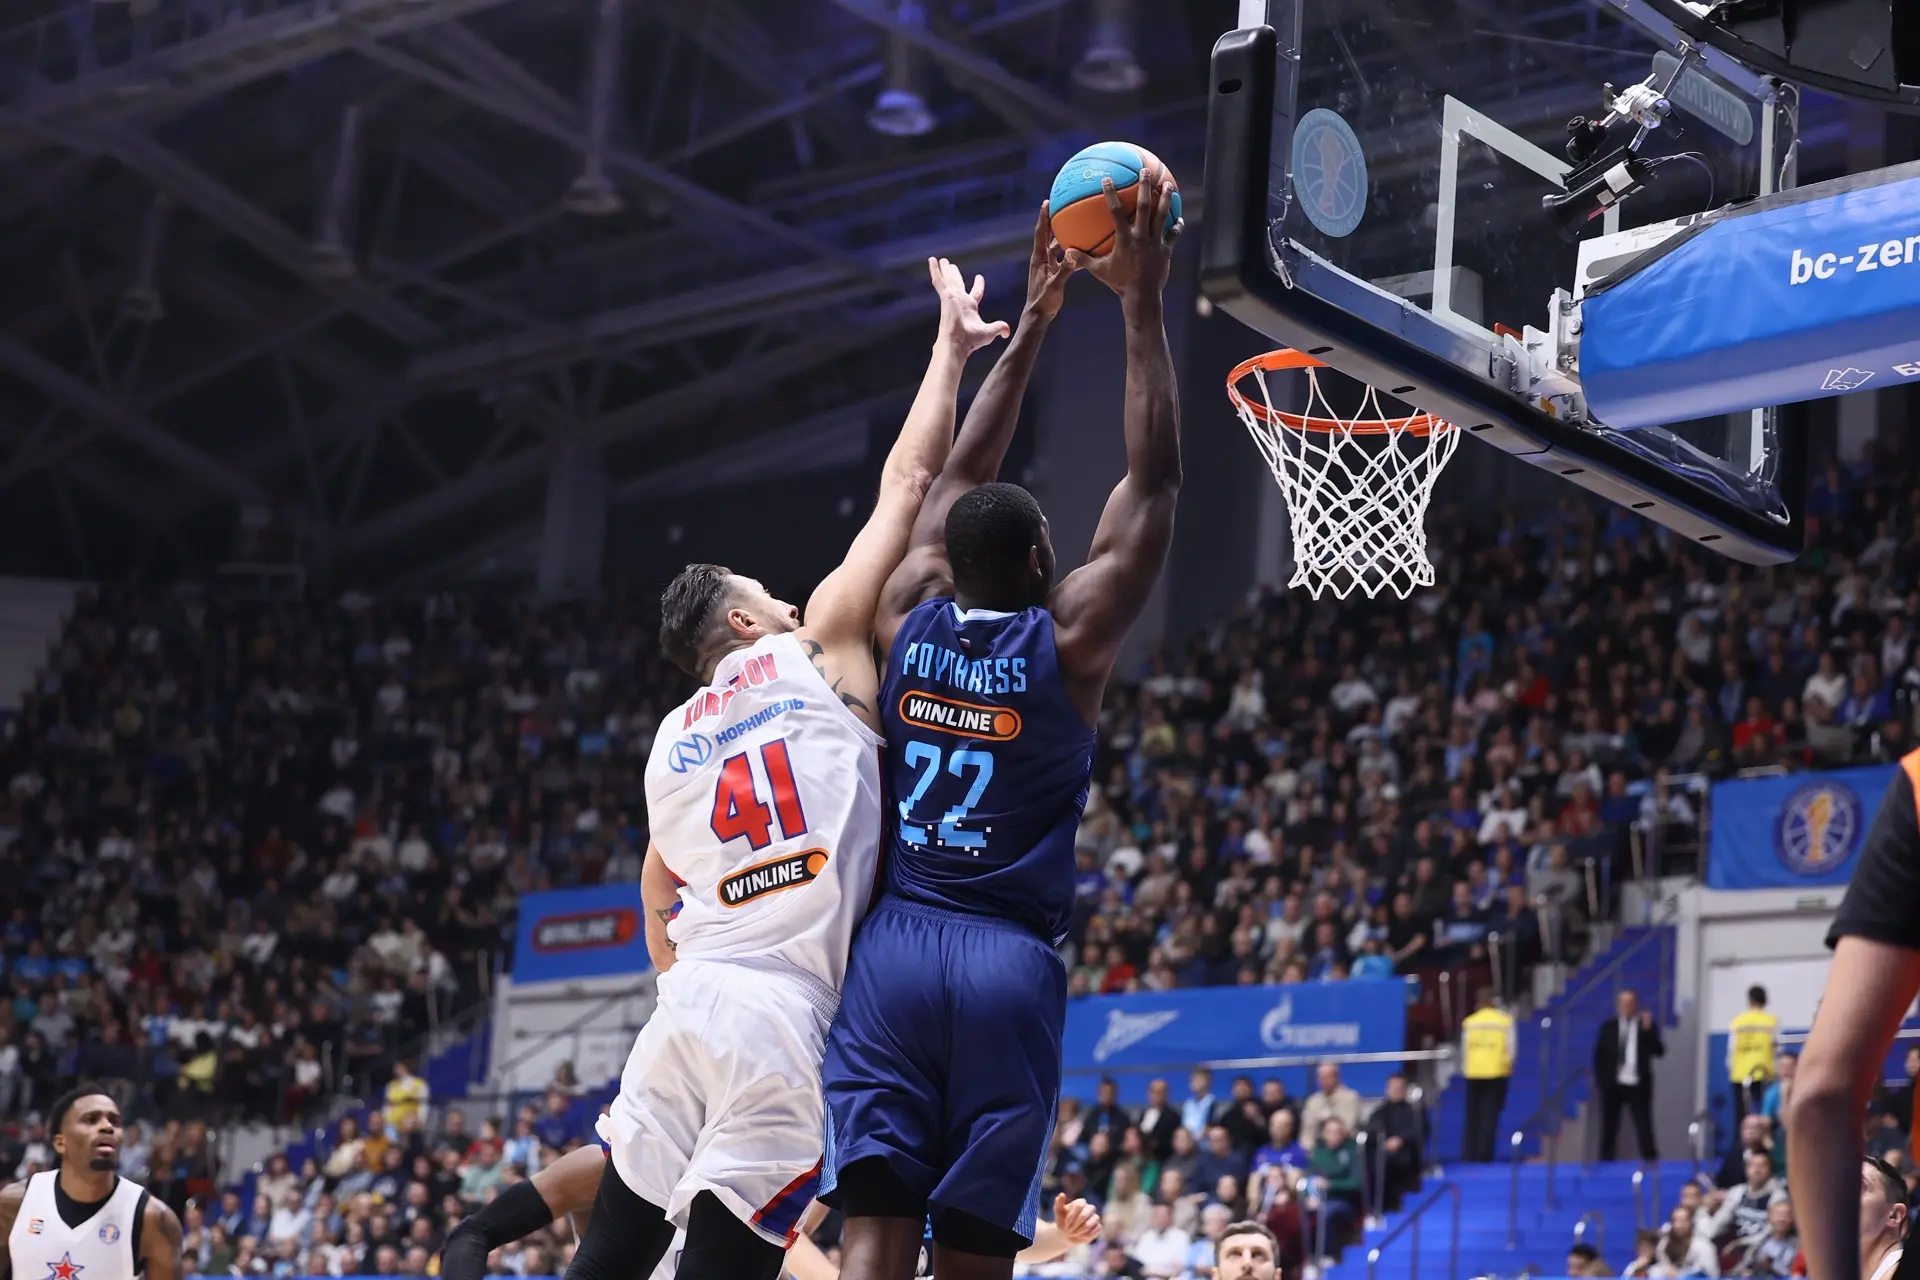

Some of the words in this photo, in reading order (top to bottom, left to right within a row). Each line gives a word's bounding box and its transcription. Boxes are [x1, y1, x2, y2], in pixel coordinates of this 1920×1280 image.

[902, 642, 1027, 695] POYTHRESS
[715, 698, 805, 746] НОРНИКЕЛЬ
[909, 698, 992, 732] WINLINE
[710, 737, 808, 852] 41
[899, 740, 994, 848] 22
[726, 860, 804, 902] WINLINE
